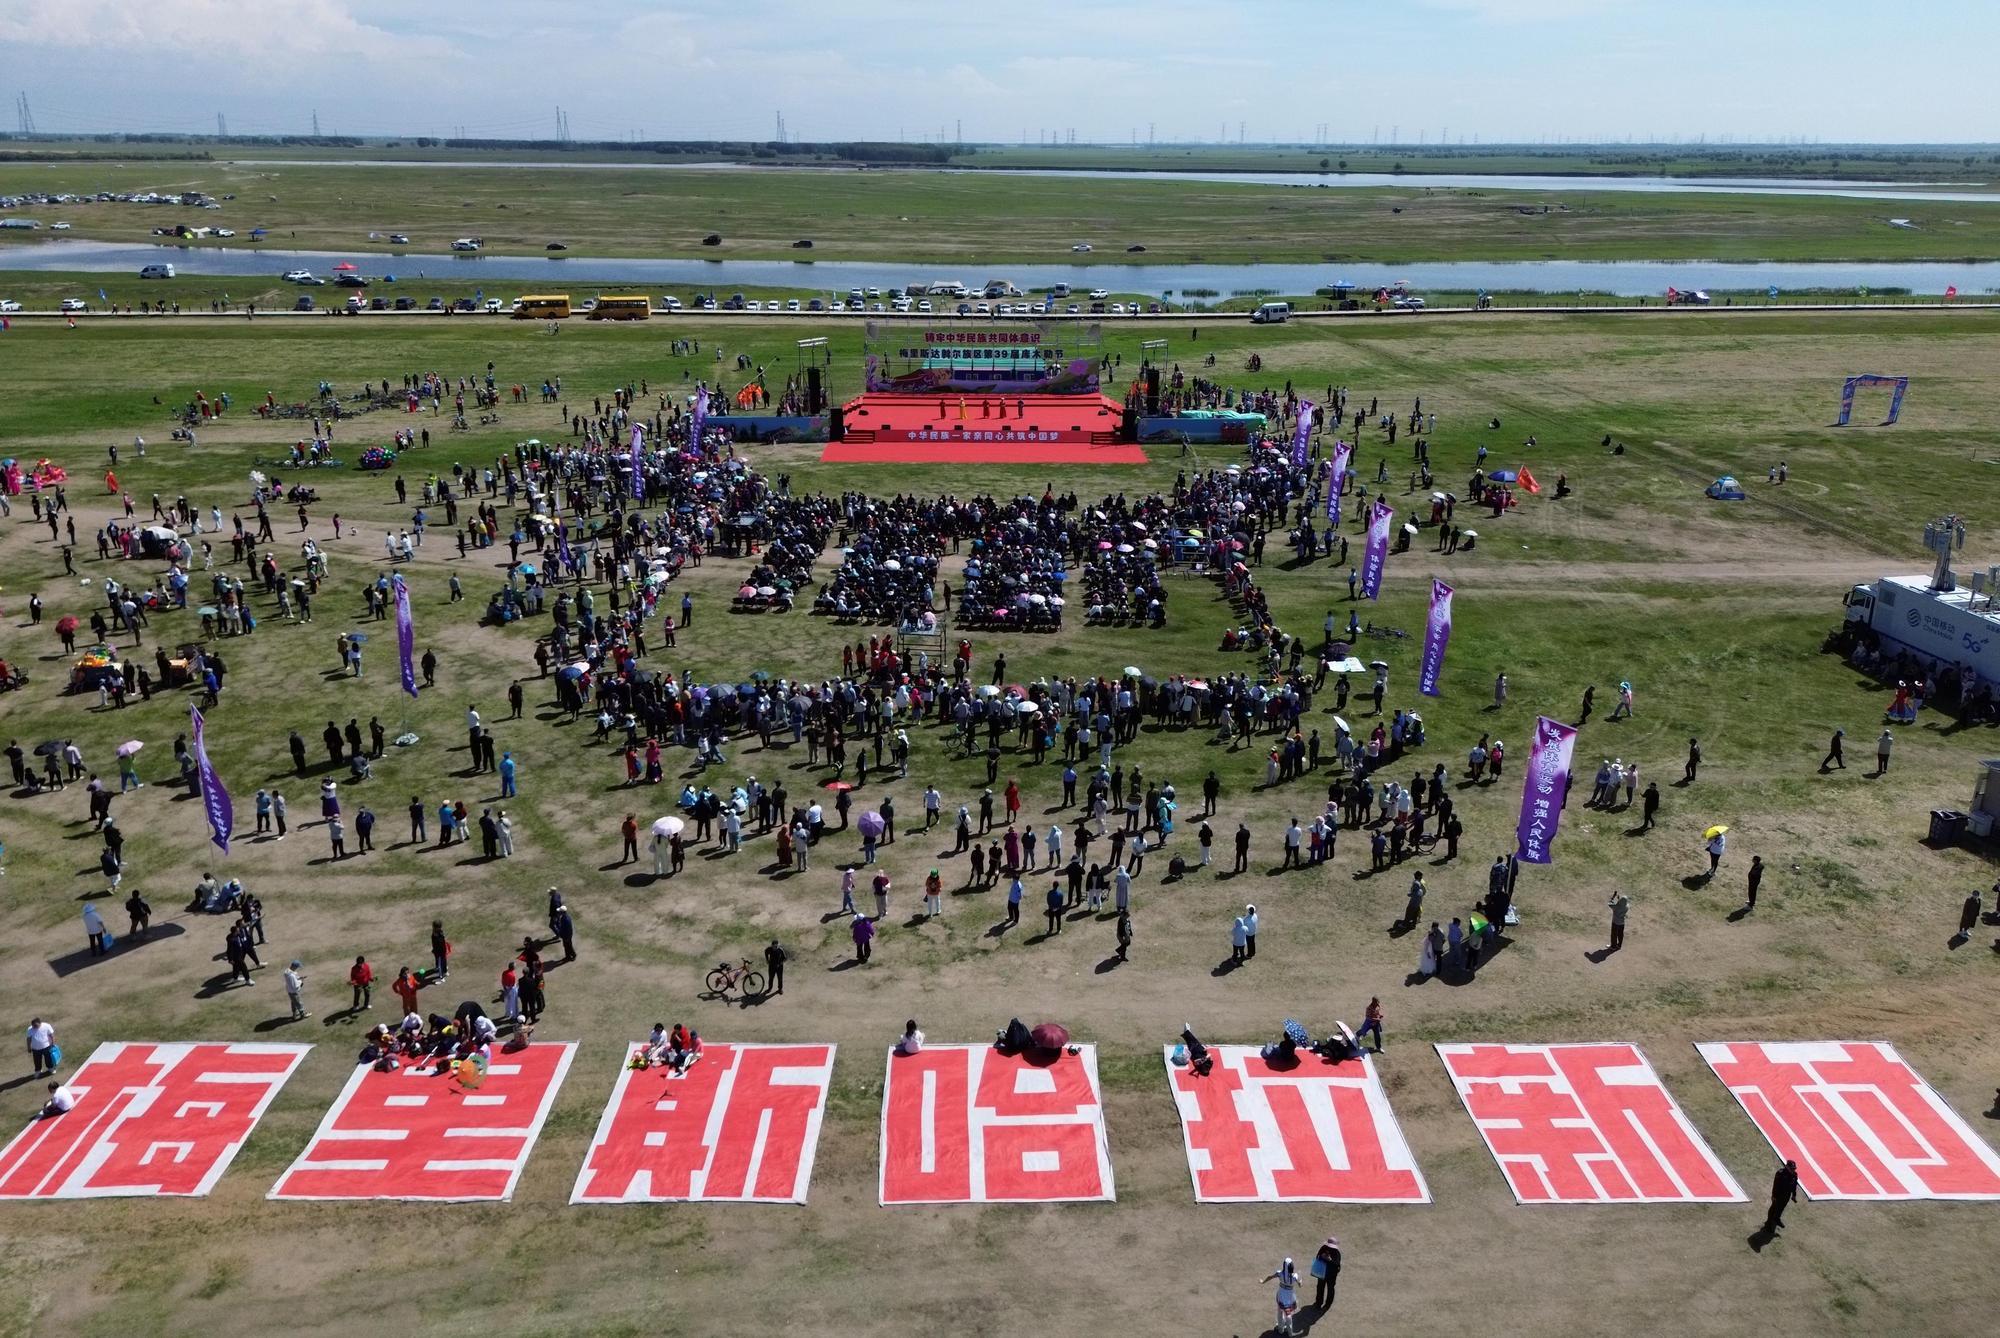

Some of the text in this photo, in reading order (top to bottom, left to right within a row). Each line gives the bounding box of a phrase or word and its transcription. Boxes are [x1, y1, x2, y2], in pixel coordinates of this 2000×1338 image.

[925, 333, 1040, 343] 铸牢中华民族共同体意识
[1924, 615, 1955, 634] 中国移动
[1526, 728, 1562, 860] 发展体育运动 增强人民体质
